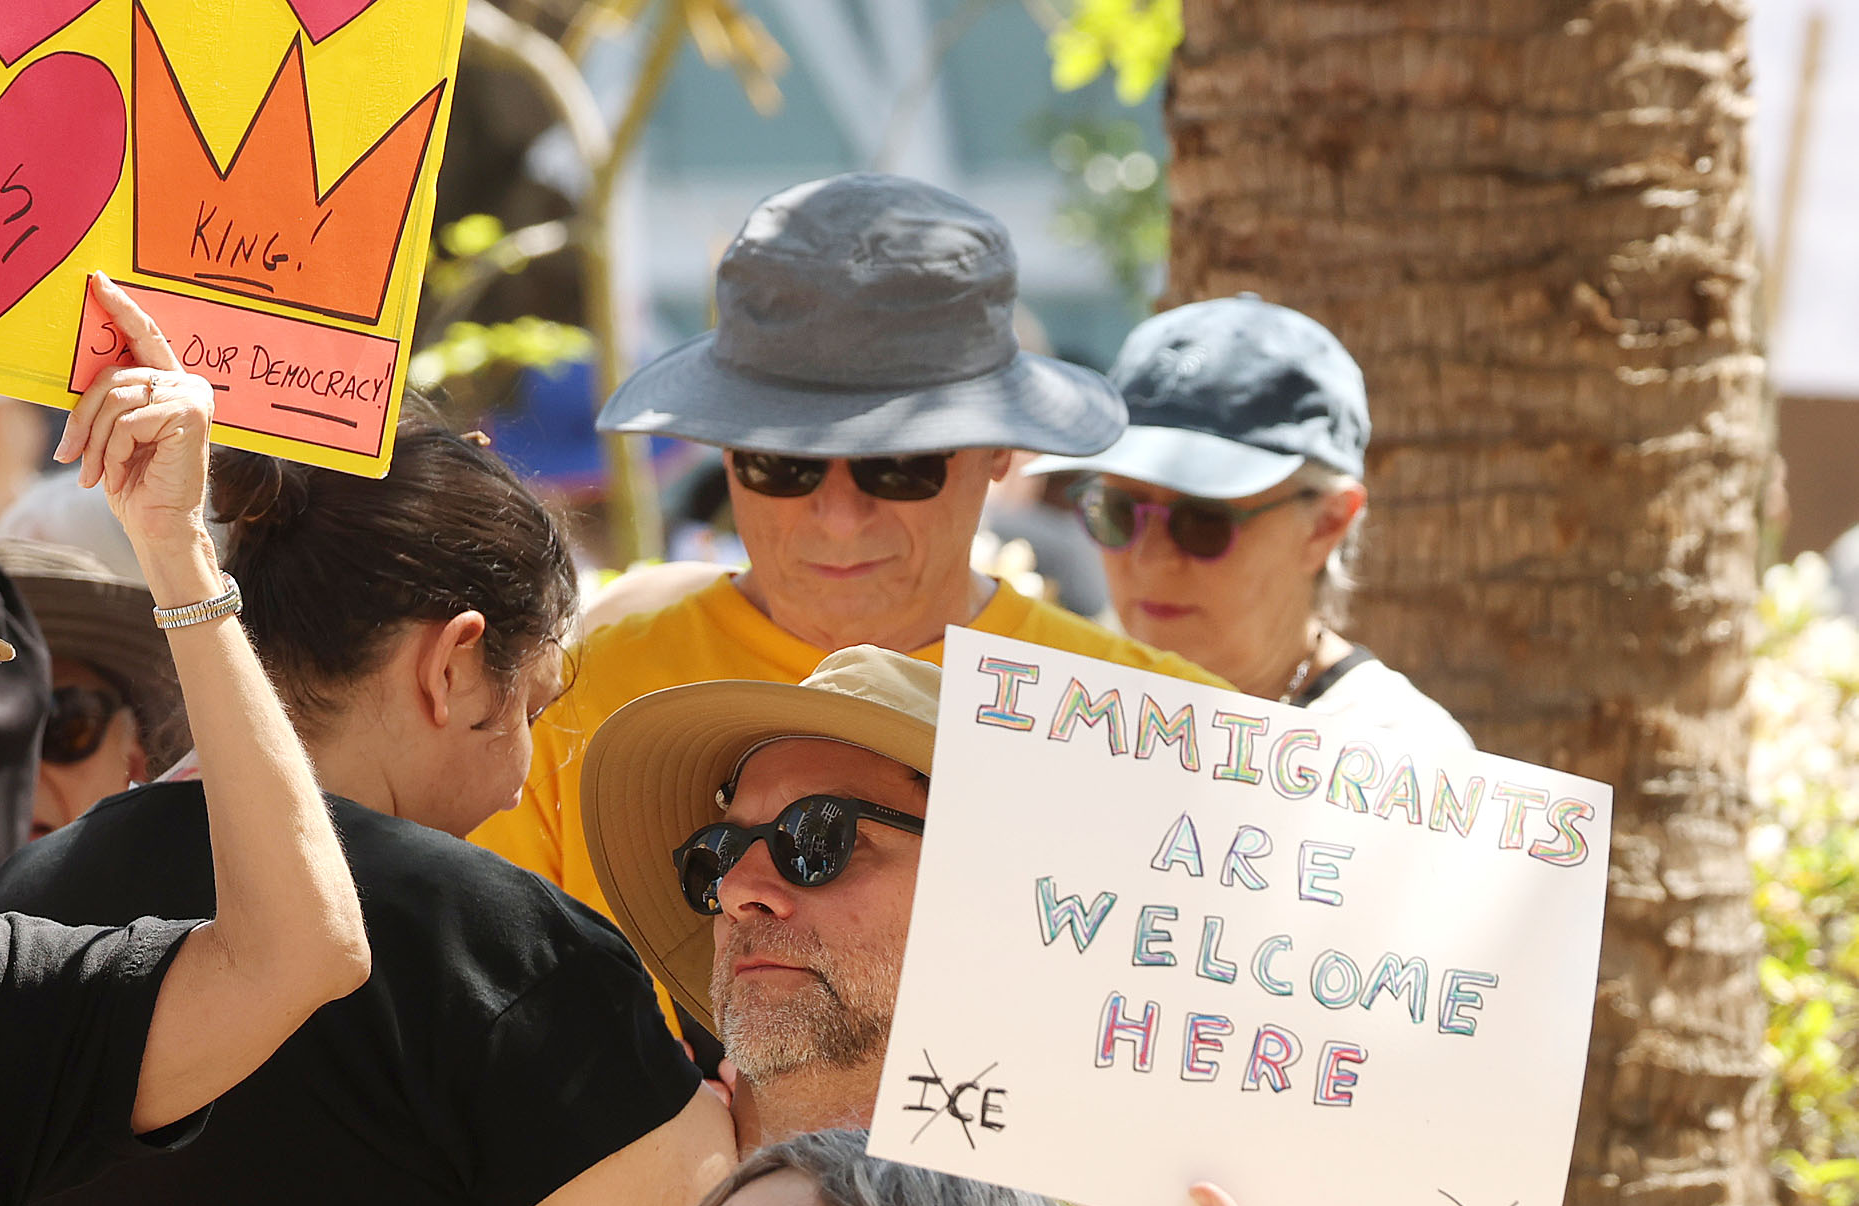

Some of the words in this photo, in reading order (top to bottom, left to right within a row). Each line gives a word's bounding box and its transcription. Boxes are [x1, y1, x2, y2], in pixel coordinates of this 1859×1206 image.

[190, 200, 333, 272] KING!
[182, 334, 238, 374] OUR
[249, 345, 392, 410] DEMOCRACY!
[977, 656, 1594, 866] IMMIGRANTS
[1151, 811, 1355, 906] ARE
[1036, 876, 1499, 1036] WELCOME
[1094, 991, 1369, 1107] HERE
[903, 1074, 1008, 1132] ICE
